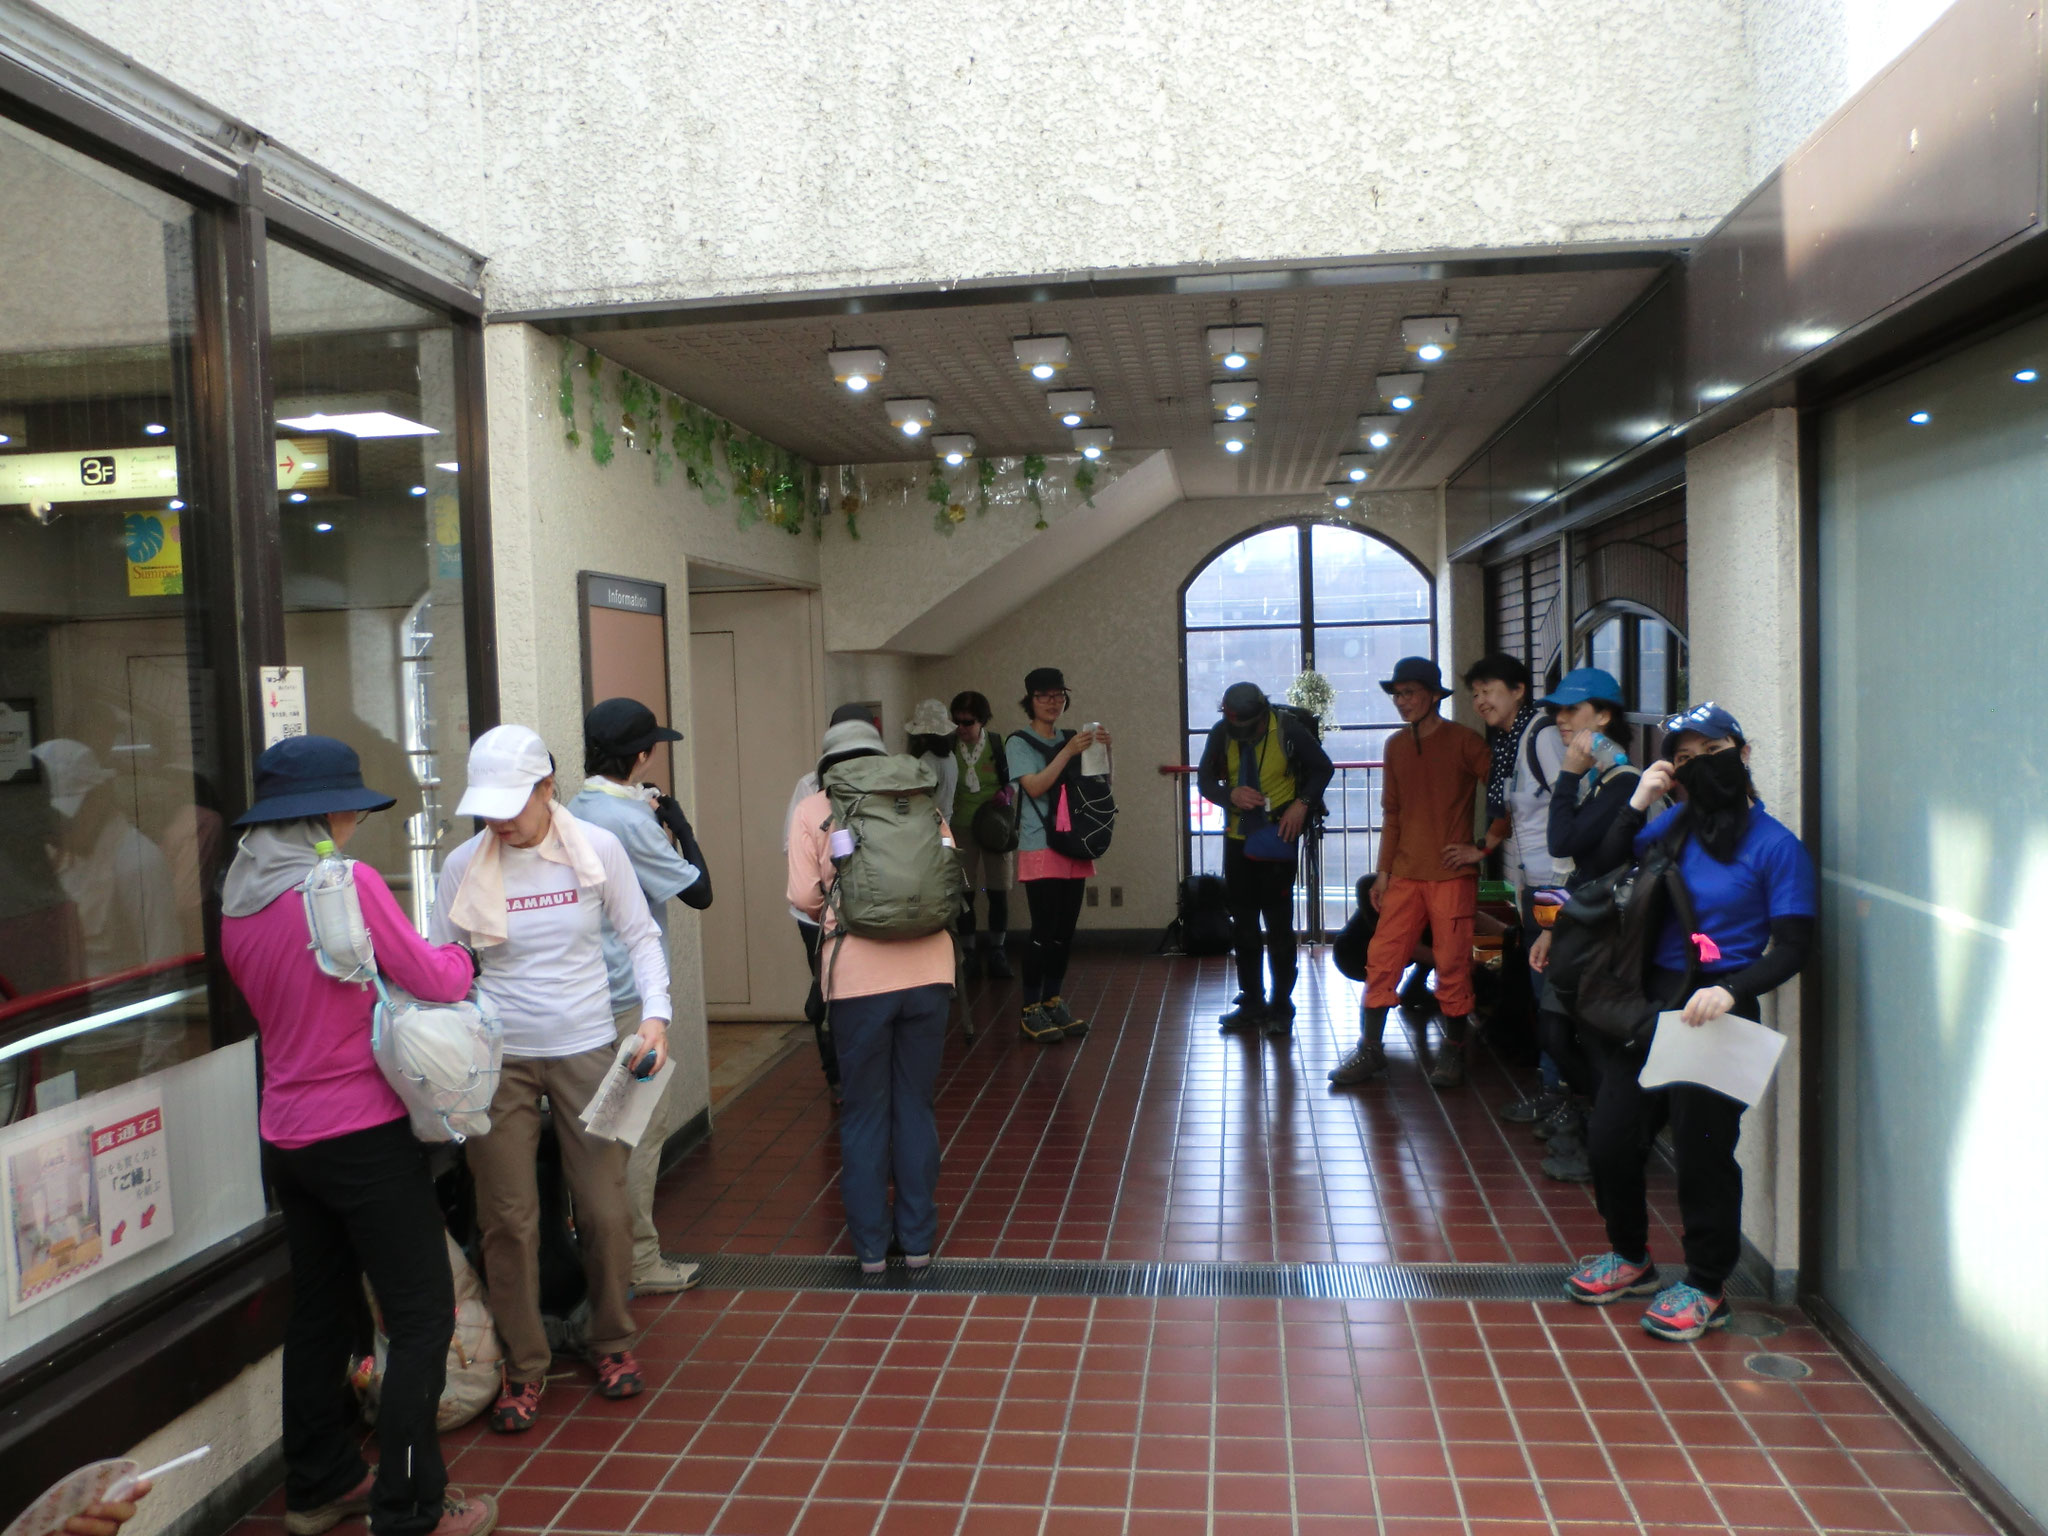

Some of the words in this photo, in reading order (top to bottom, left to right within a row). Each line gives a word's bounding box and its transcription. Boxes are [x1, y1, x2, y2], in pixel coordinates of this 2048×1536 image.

[83, 458, 114, 485] 3F
[133, 566, 180, 580] Summer
[608, 588, 648, 608] Information
[95, 1114, 158, 1153] 貫通石
